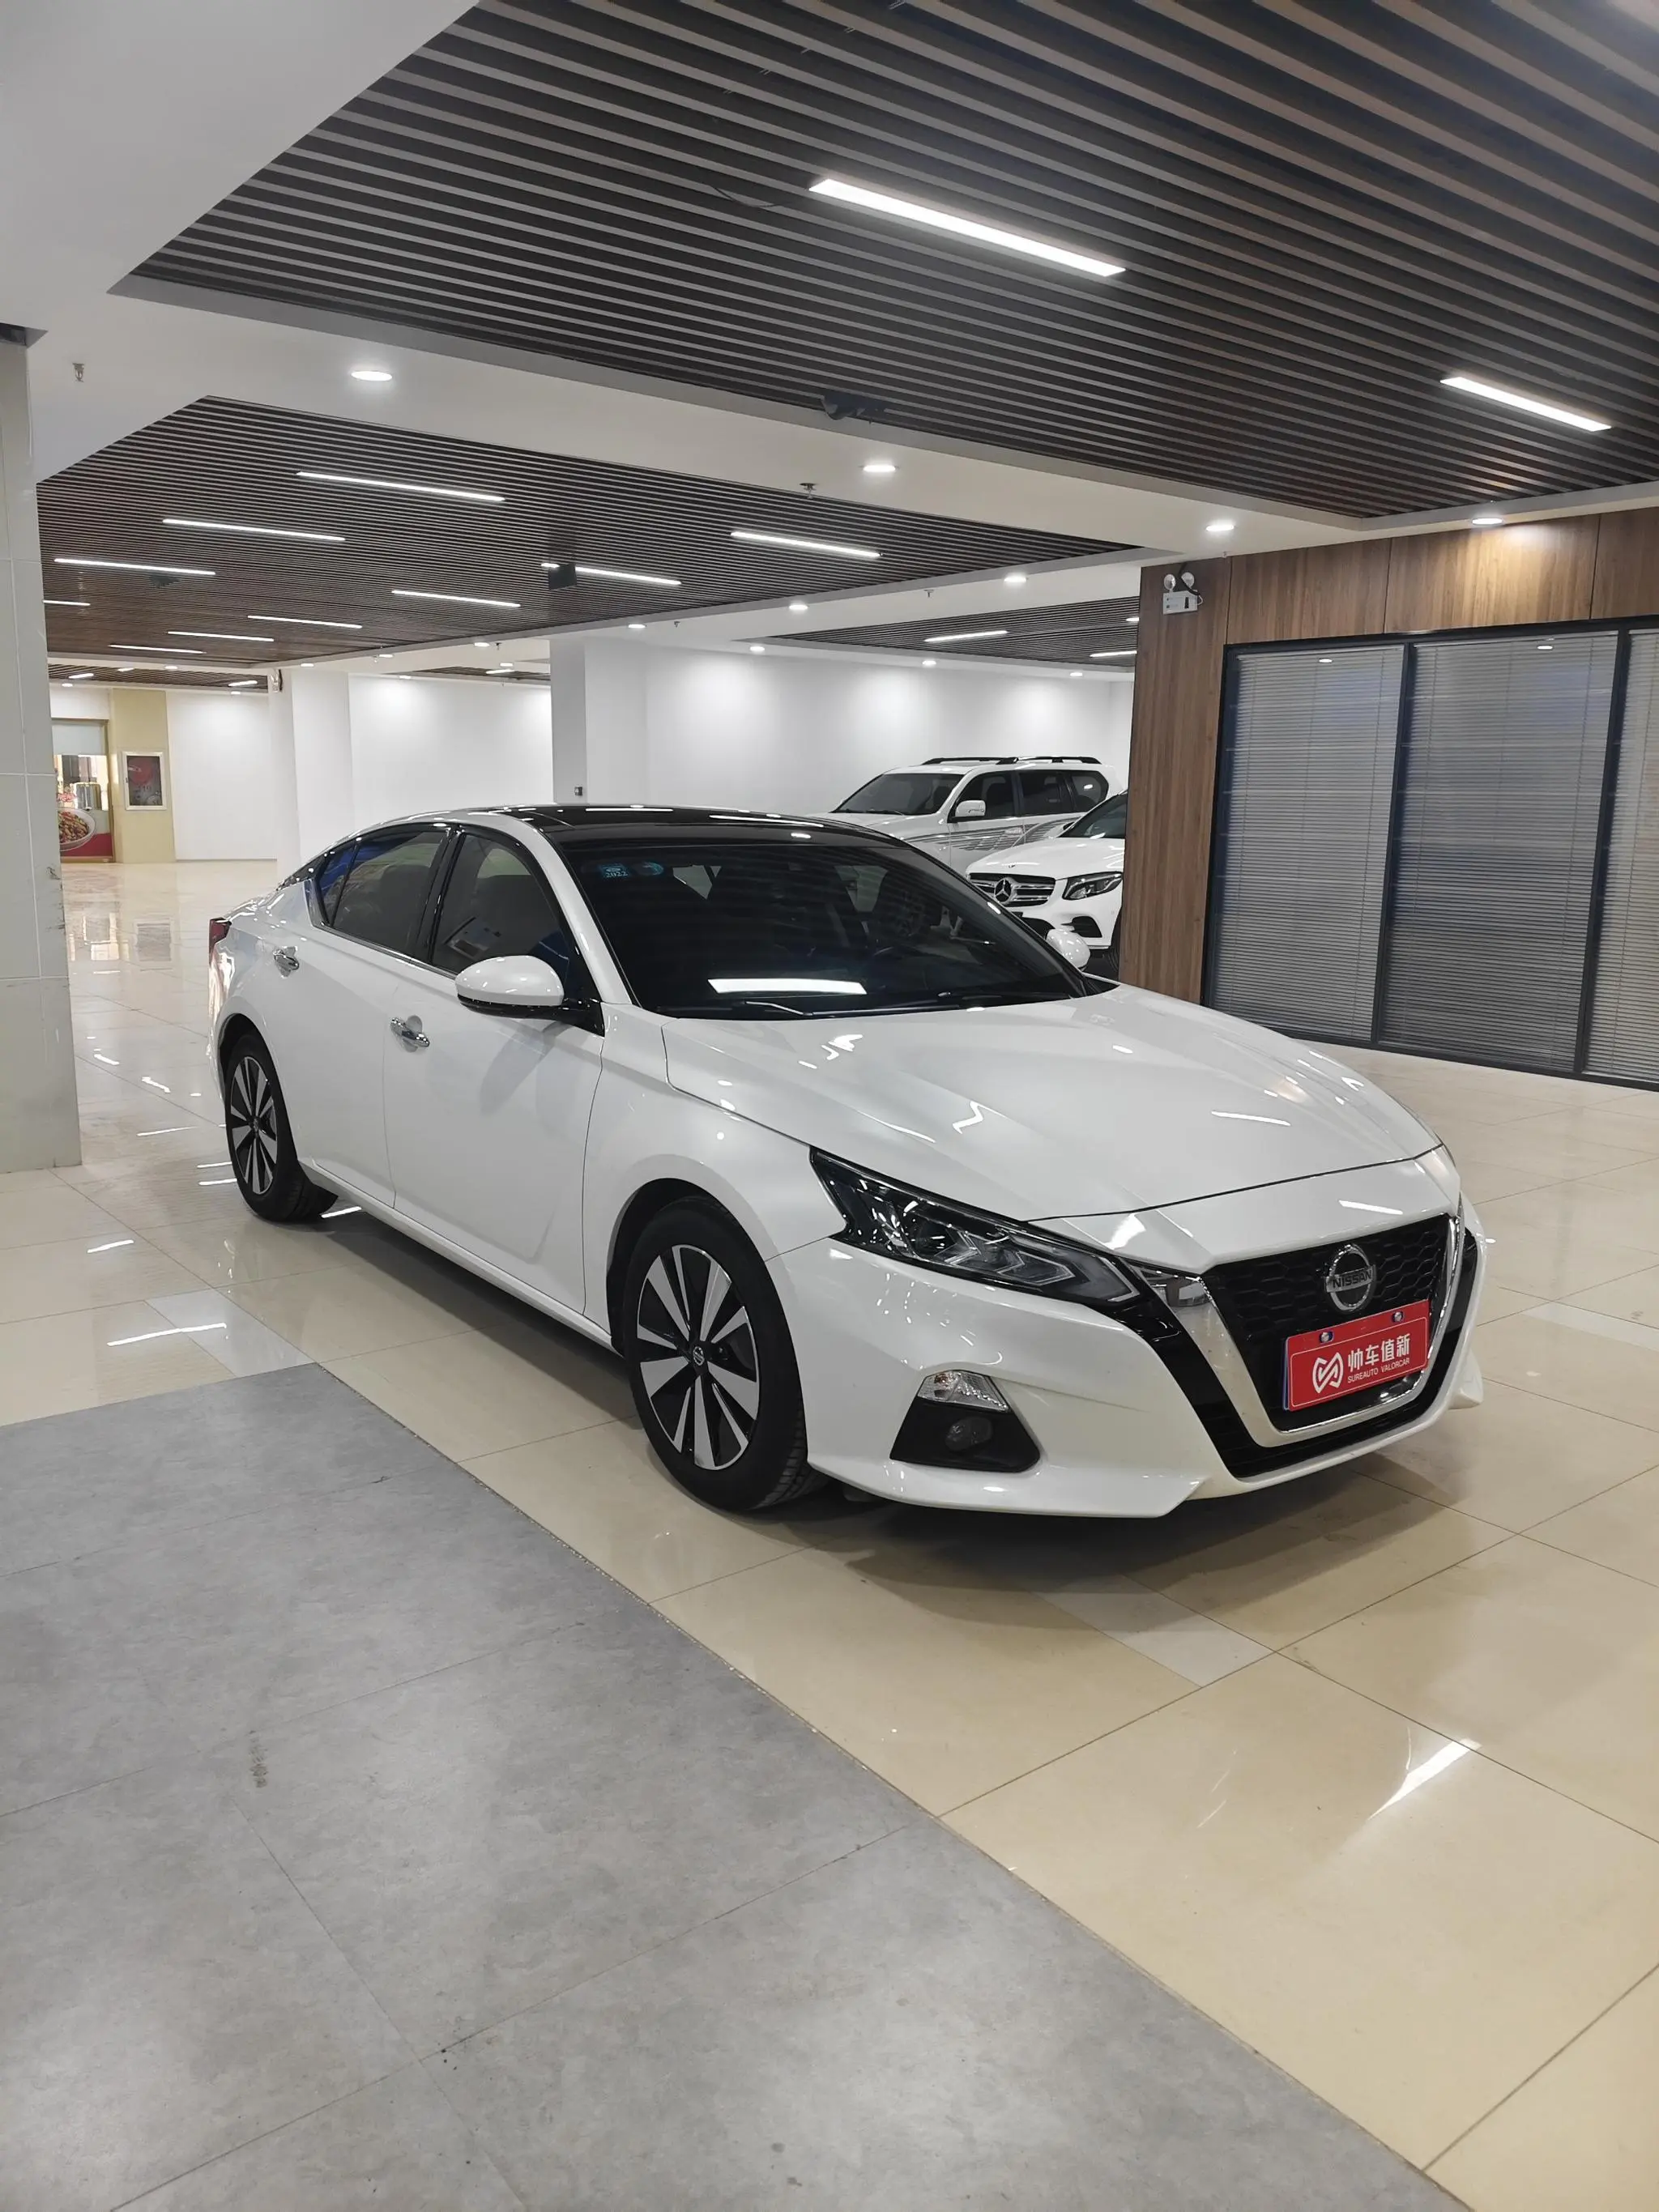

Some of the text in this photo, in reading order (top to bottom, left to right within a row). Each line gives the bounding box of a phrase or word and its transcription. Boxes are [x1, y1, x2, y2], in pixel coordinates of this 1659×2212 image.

[1333, 1269, 1372, 1288] NISSAN
[1347, 1332, 1411, 1372] 帅车值新
[1347, 1357, 1410, 1384] SUREAUTO VALORCAR
